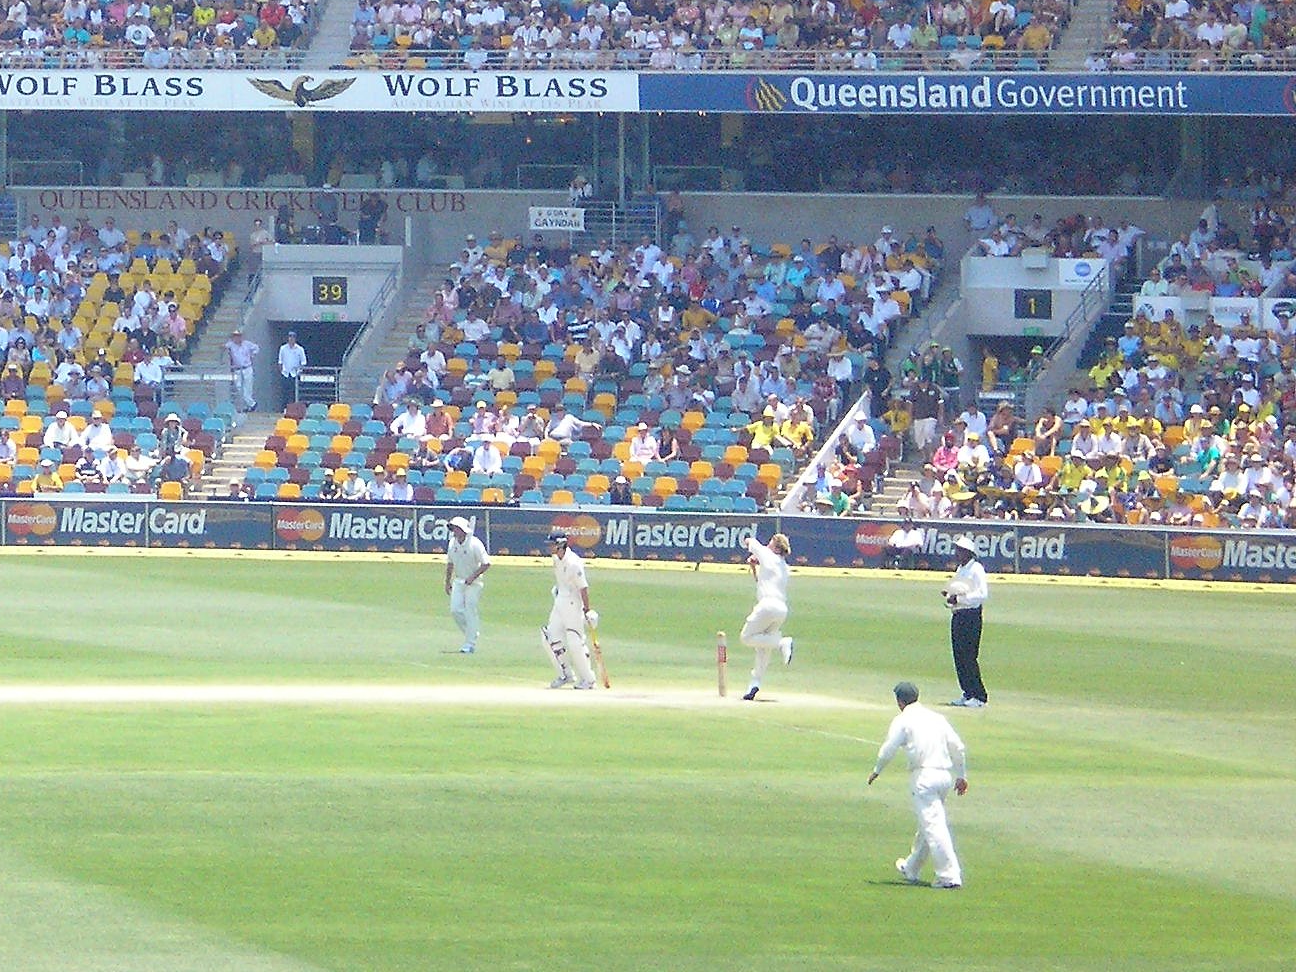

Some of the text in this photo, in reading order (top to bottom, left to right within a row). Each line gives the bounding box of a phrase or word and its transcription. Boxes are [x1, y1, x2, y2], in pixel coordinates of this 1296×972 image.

[93, 73, 205, 97] BLASS
[382, 74, 608, 99] WOLF BLASS
[790, 76, 1188, 110] Queensland Government
[39, 190, 218, 211] QUEENSLAND
[396, 191, 465, 213] CLUB
[319, 284, 342, 301] 39
[7, 513, 57, 527] MasterCard
[276, 518, 326, 531] MasterCard
